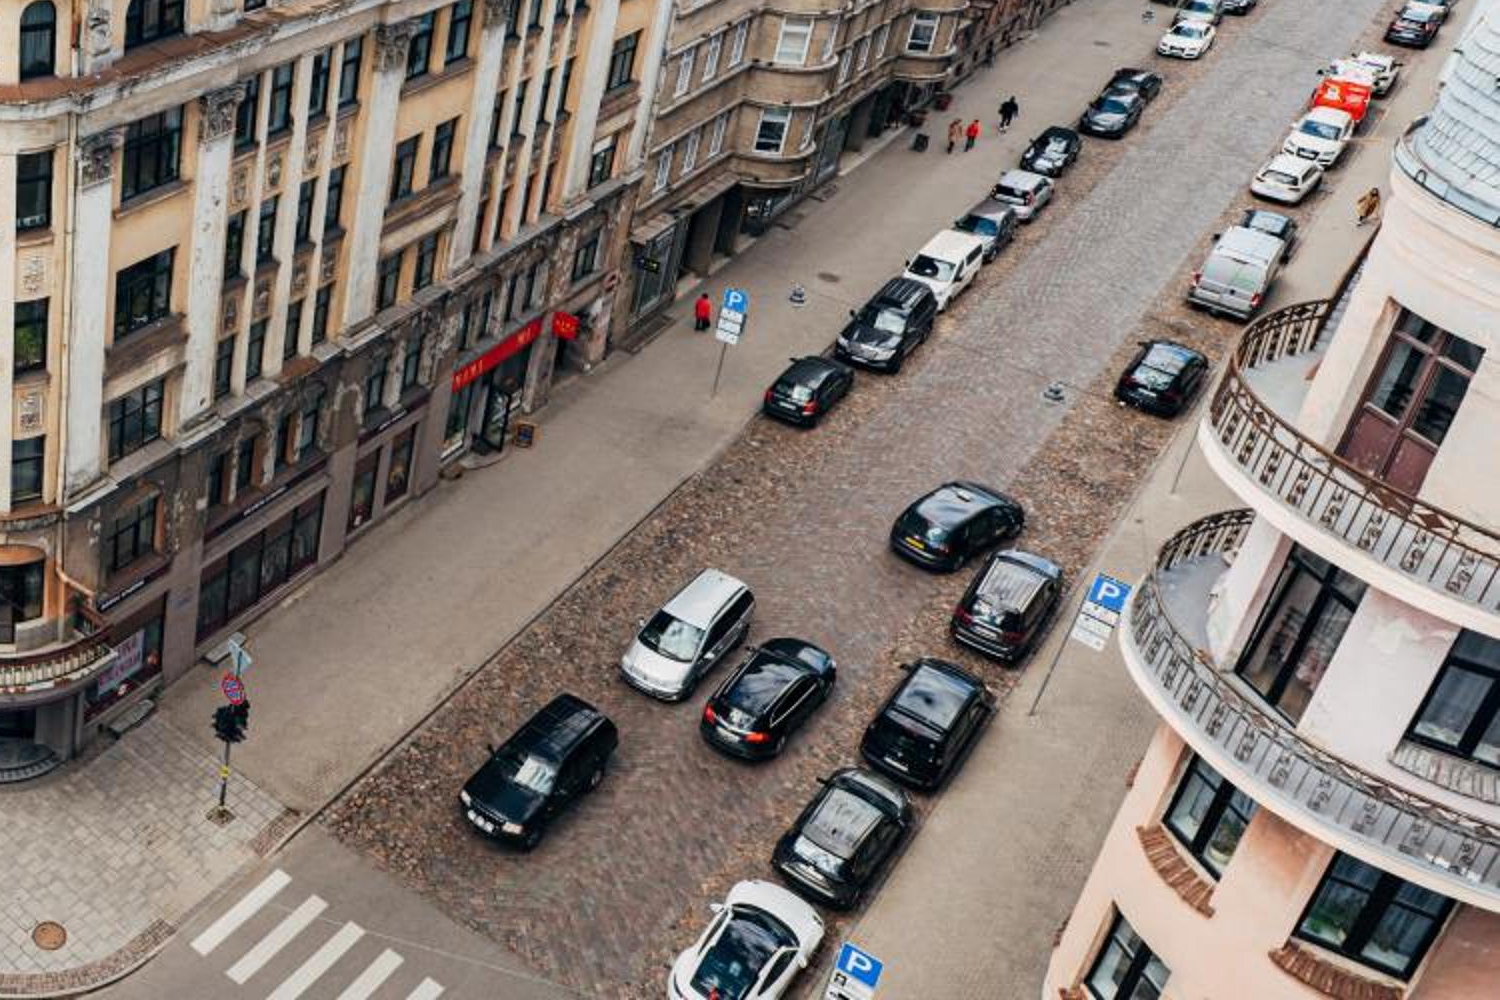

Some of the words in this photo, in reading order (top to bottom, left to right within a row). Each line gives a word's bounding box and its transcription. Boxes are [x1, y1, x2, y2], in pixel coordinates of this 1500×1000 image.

[728, 291, 743, 307] P
[1097, 581, 1120, 600] P
[845, 950, 872, 972] P
